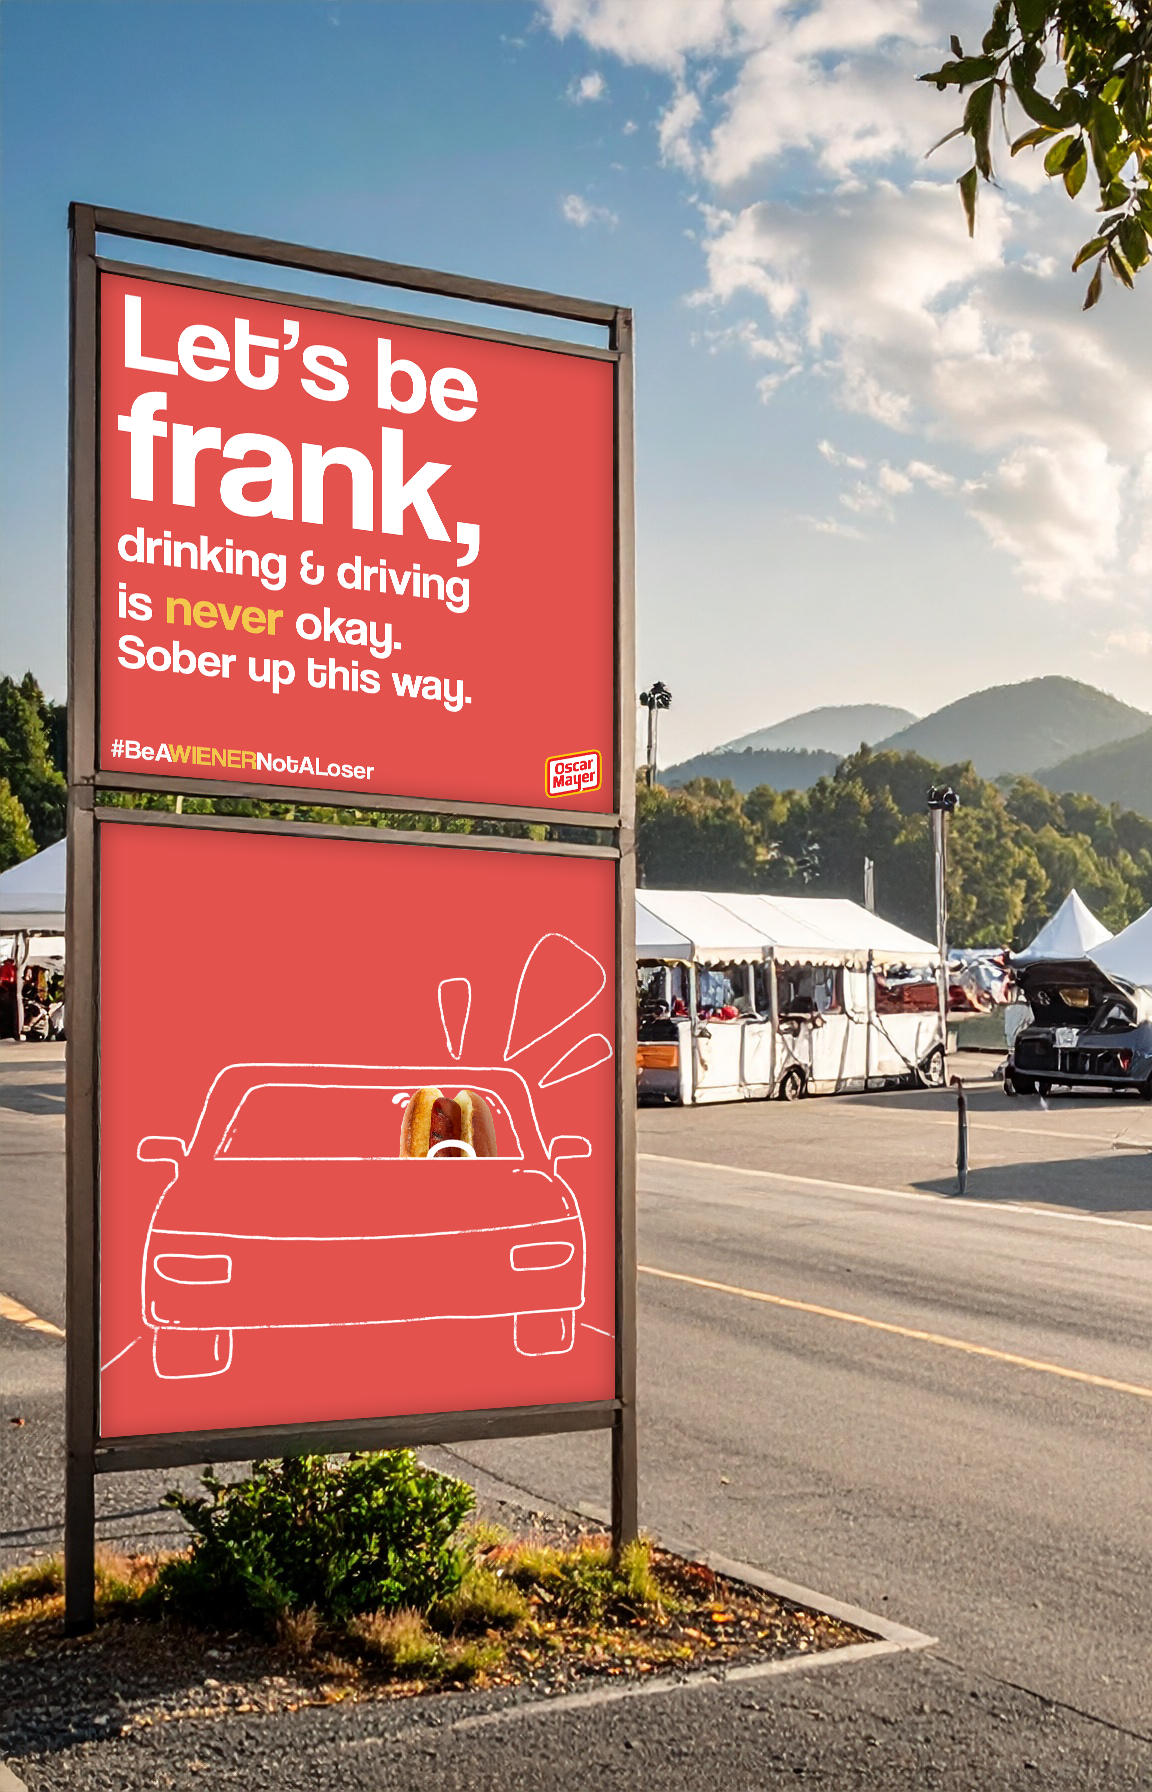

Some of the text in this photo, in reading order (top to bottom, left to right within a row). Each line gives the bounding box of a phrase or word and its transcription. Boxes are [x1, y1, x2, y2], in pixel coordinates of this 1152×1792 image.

[377, 337, 479, 423] be
[117, 391, 481, 568] frank,
[117, 526, 470, 614] drinking & driving
[118, 581, 402, 660] is never okay.
[117, 634, 472, 713] Sober up this way.
[110, 738, 375, 780] #BeAWIENERNotALoser
[552, 771, 596, 791] Mayer
[555, 759, 594, 775] Oscar
